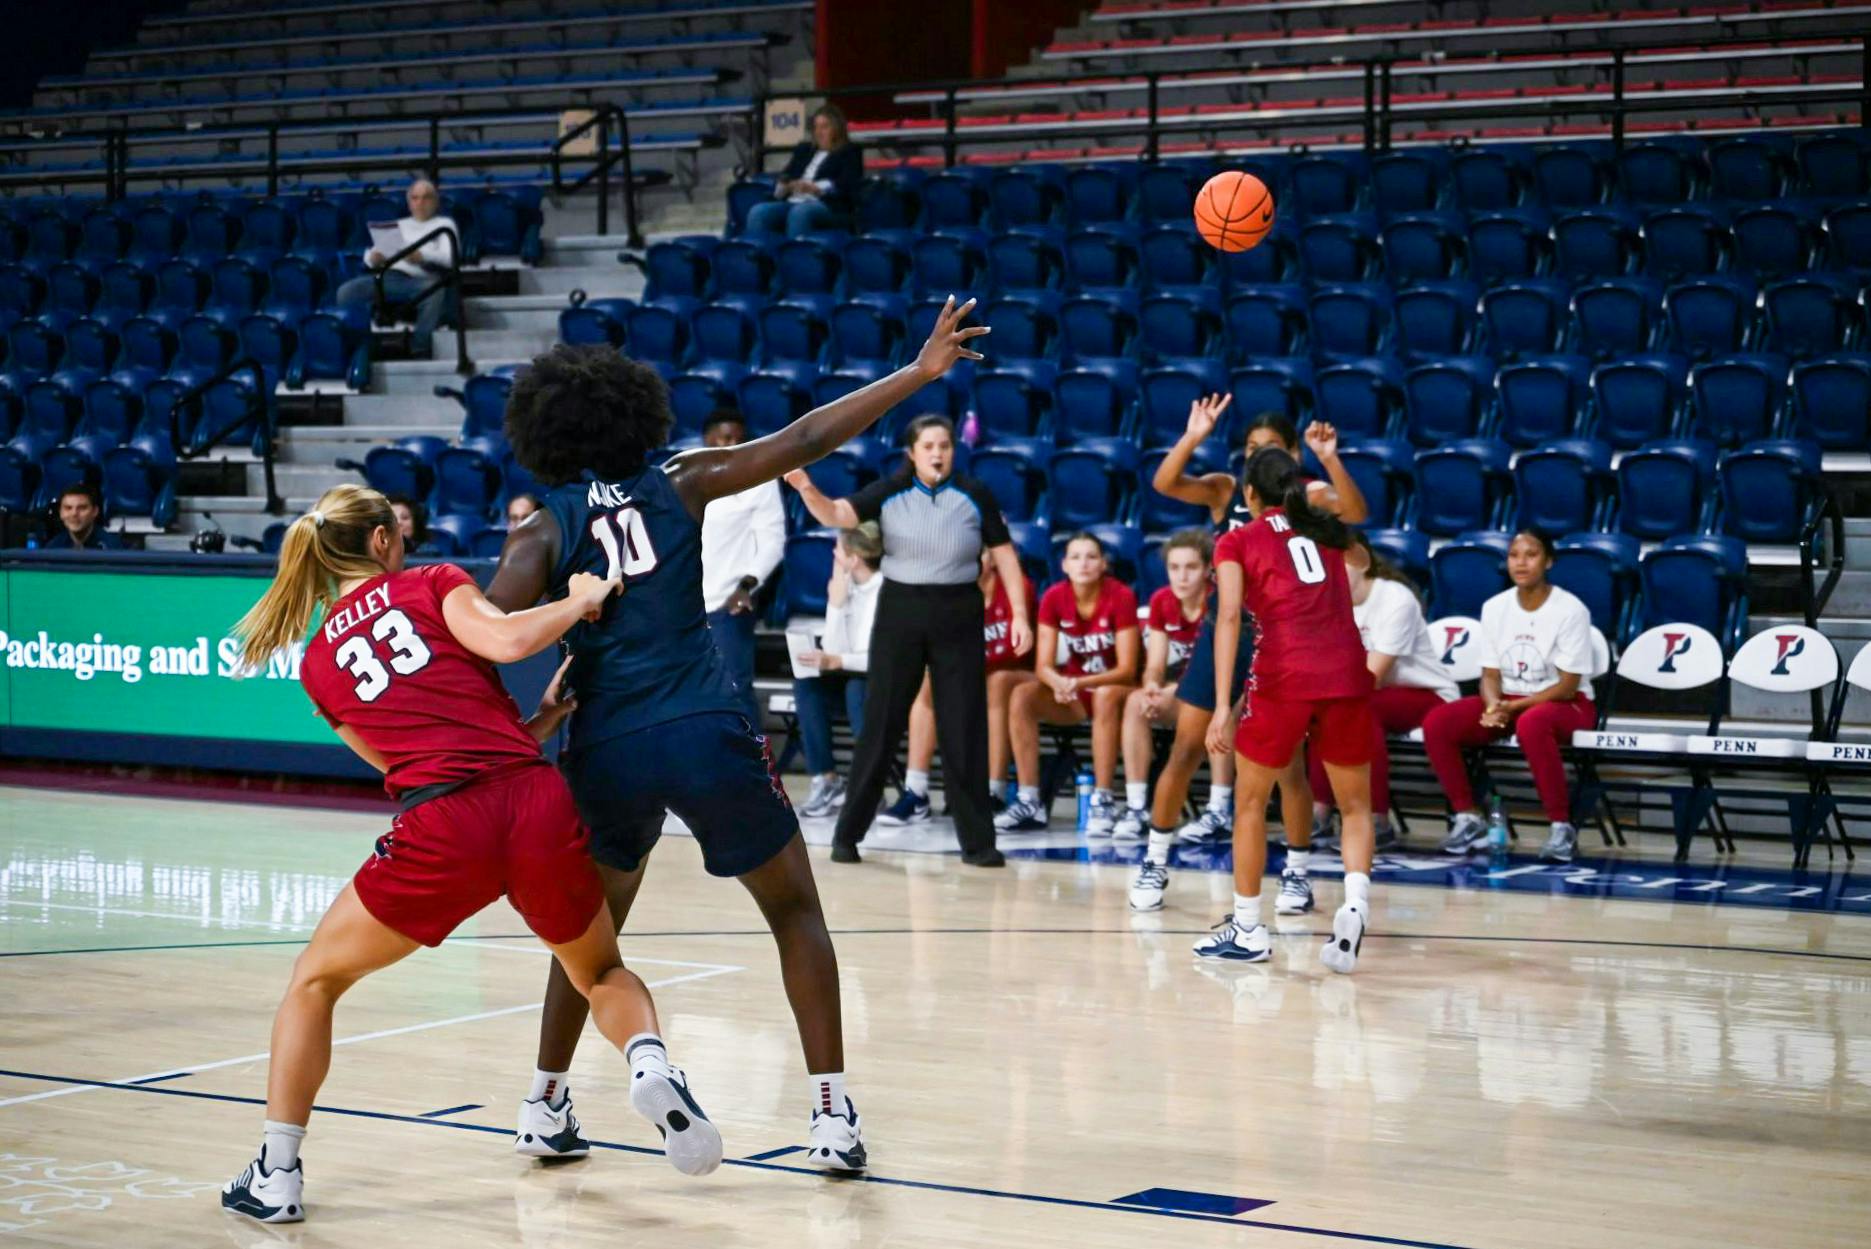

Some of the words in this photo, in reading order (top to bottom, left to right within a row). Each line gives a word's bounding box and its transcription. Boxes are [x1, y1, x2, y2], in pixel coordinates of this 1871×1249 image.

[772, 112, 800, 129] 104
[591, 507, 658, 580] 10
[1287, 536, 1326, 584] 0
[324, 581, 391, 644] KELLEY
[149, 637, 210, 676] and
[335, 608, 432, 703] 33
[1596, 735, 1639, 747] PENN
[1713, 740, 1757, 753] PENN
